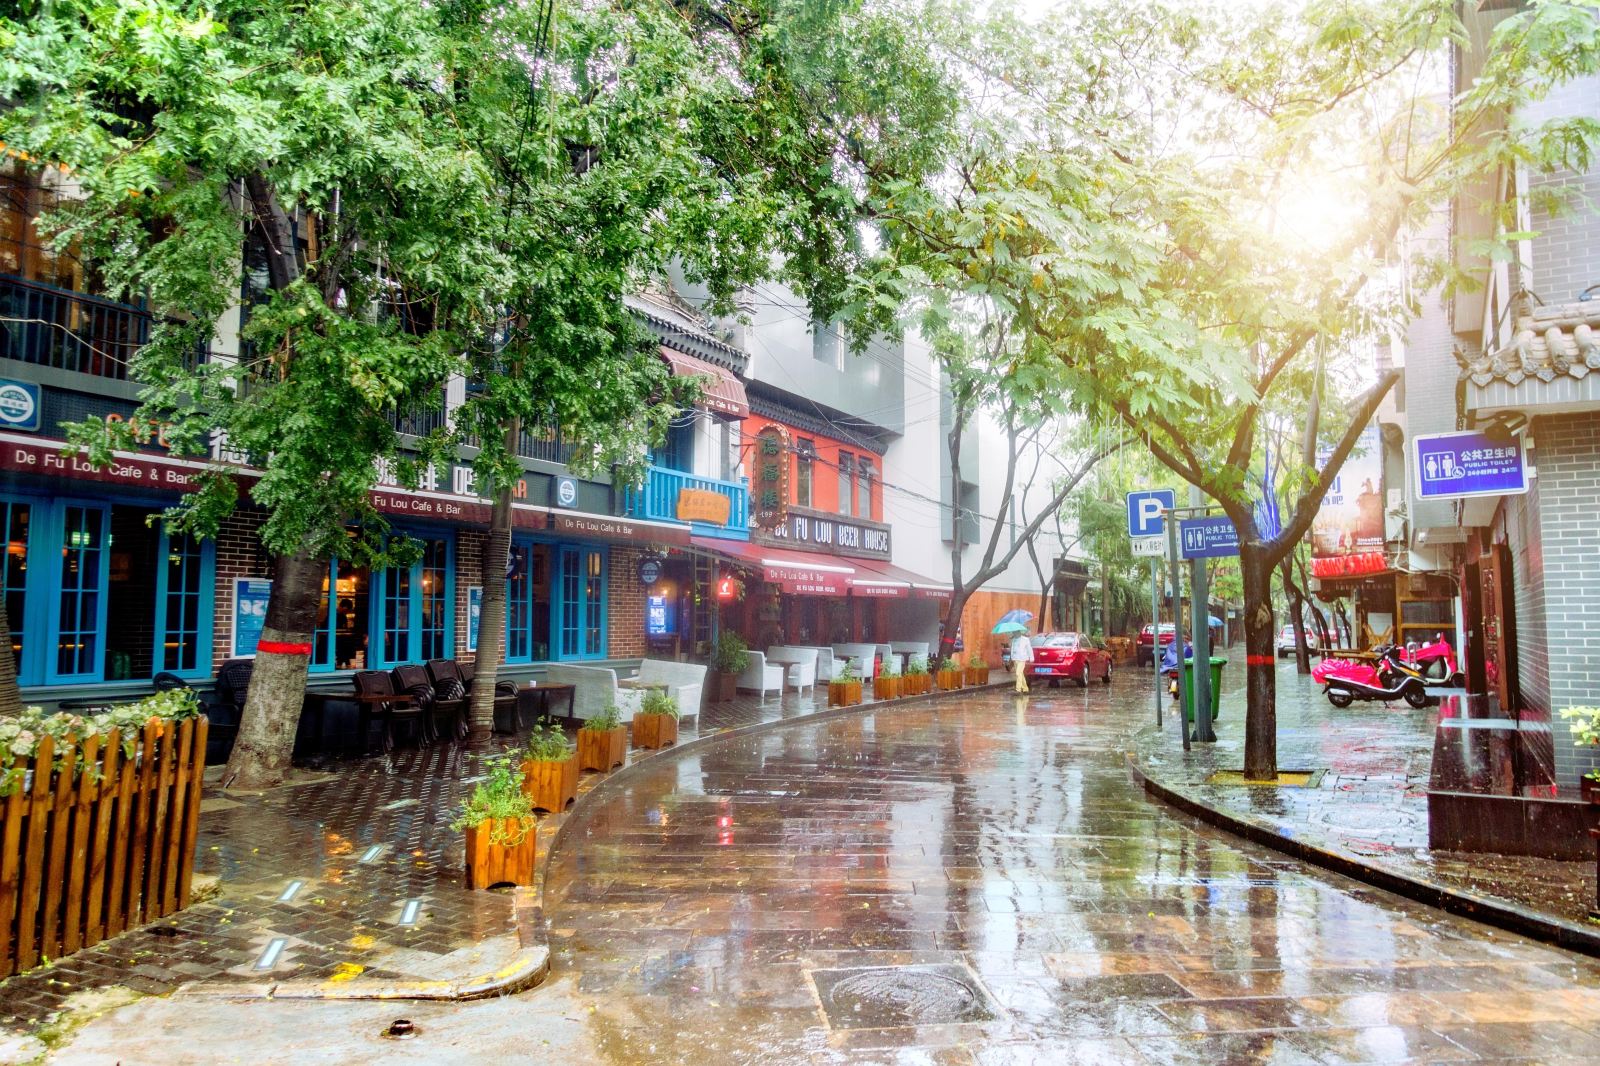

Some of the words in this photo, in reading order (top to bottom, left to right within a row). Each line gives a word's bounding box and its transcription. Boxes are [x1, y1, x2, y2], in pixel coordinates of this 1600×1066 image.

[1460, 447, 1516, 461] 公共卫生间
[15, 450, 36, 465] De
[45, 454, 64, 469] Fu
[73, 457, 100, 474] Lou
[109, 463, 142, 479] Cafe
[150, 469, 159, 481] &
[166, 472, 190, 485] Bar
[374, 496, 386, 507] Fu
[391, 498, 408, 509] Lou
[412, 500, 432, 512] Cafe
[436, 504, 442, 513] &
[446, 504, 461, 514] Bar
[1138, 498, 1164, 530] P
[566, 519, 574, 528] De
[587, 522, 598, 530] Lou
[600, 524, 614, 532] Cafe
[624, 526, 632, 534] Bar
[794, 517, 808, 540] FU
[814, 520, 832, 544] LOU
[838, 524, 859, 548] BEER
[864, 529, 888, 552] HOUSE
[1205, 524, 1236, 534] 公共卫生
